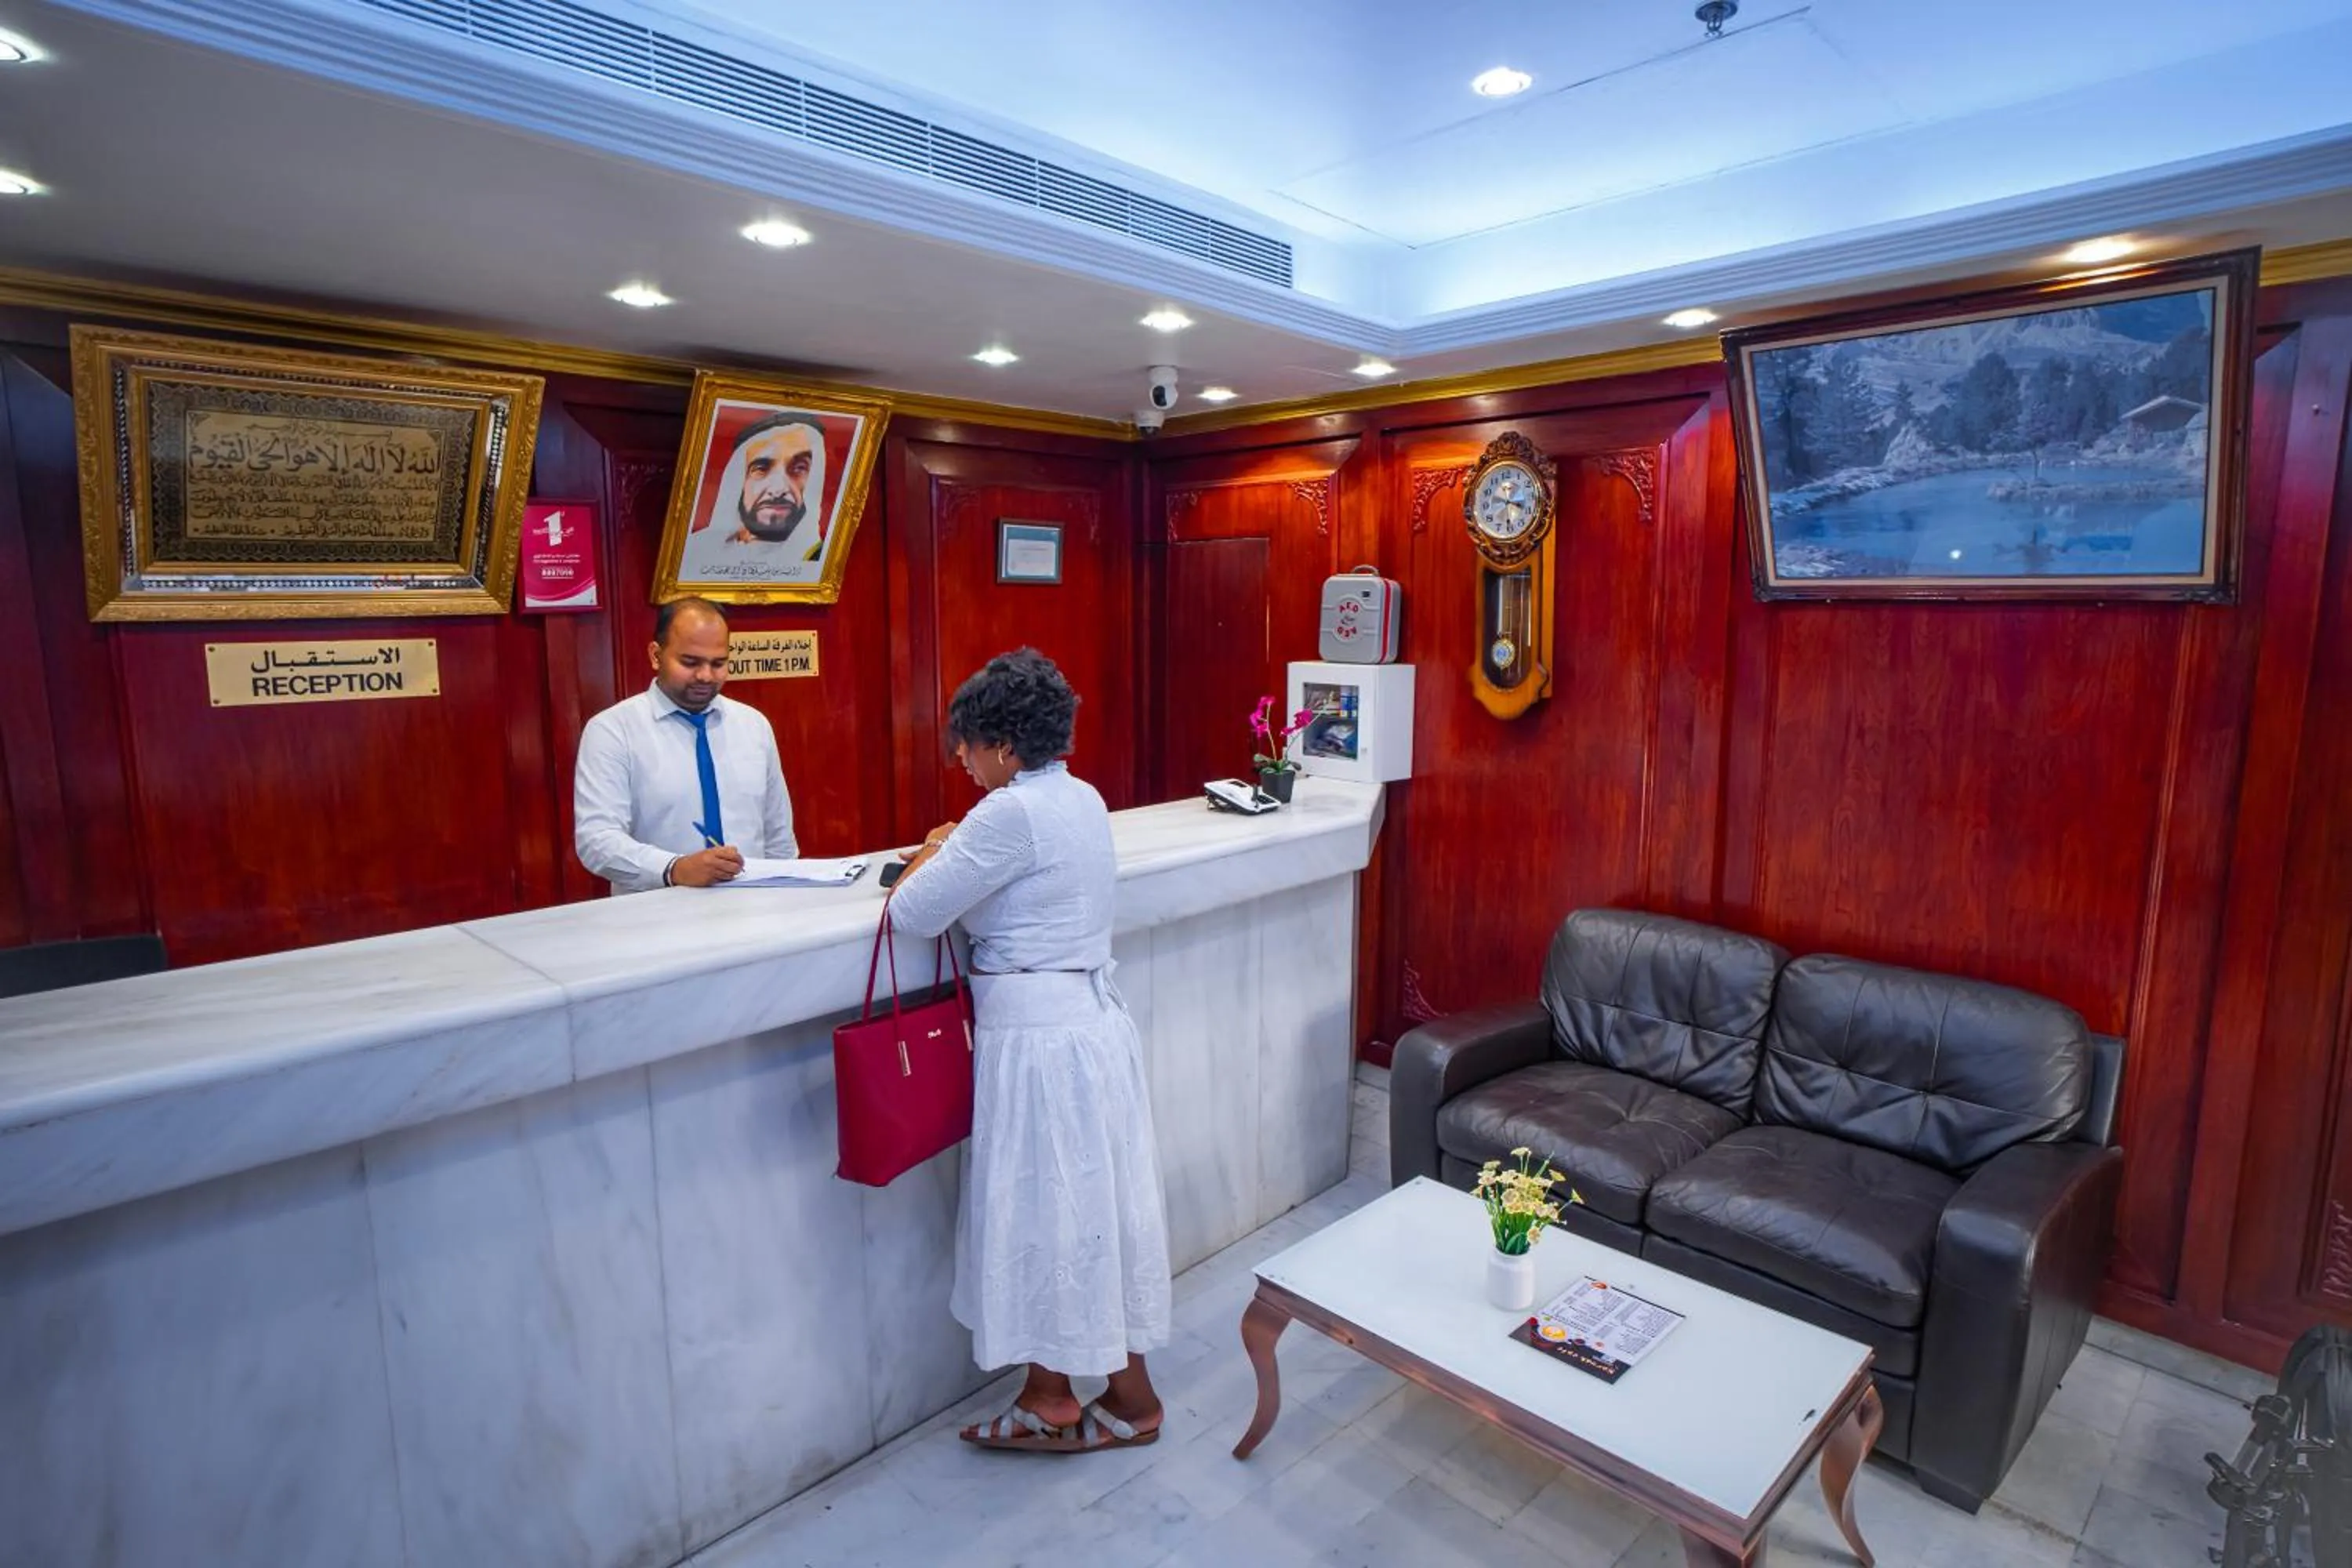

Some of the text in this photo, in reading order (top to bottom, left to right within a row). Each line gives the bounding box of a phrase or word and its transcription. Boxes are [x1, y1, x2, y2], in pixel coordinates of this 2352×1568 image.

[728, 641, 746, 655] الواح
[250, 646, 401, 673] الاستقبال
[728, 659, 751, 675] OUT
[753, 658, 782, 673] TIME
[252, 672, 404, 697] RECEPTION
